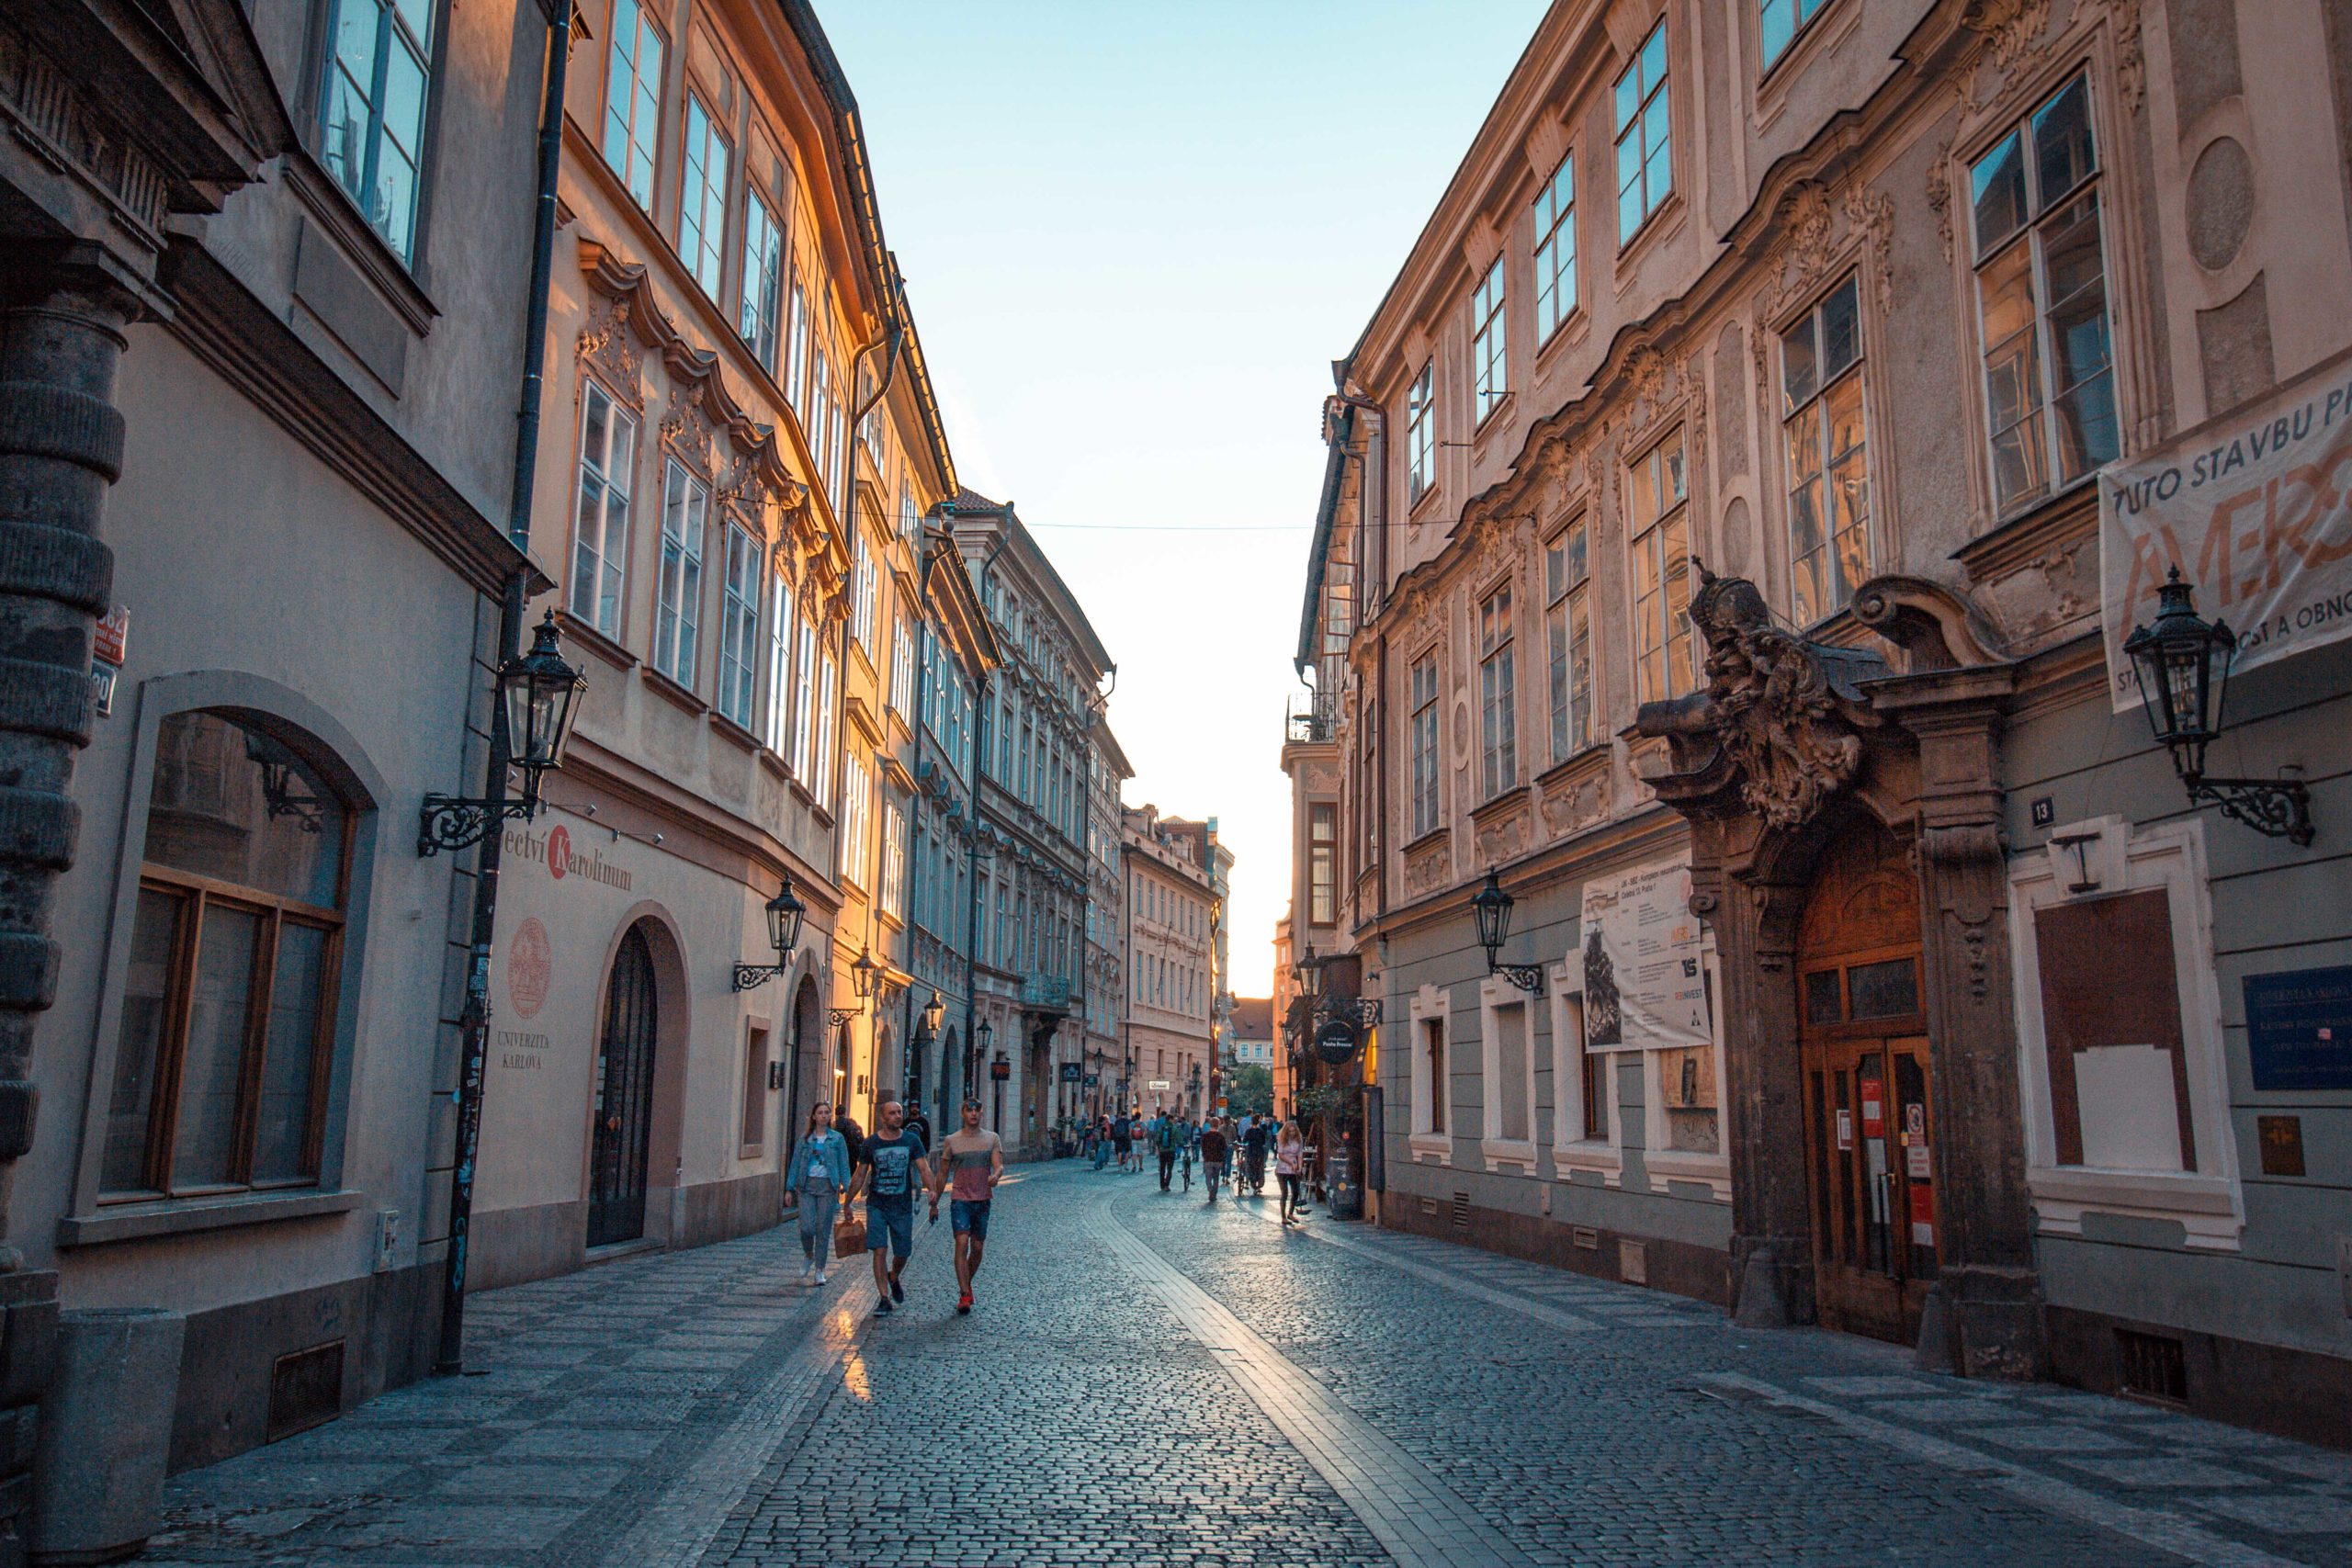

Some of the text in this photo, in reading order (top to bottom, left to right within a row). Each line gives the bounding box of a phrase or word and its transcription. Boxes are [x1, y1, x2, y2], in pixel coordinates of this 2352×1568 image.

[2113, 468, 2182, 518] TUTO
[2190, 402, 2313, 488] STAVBU
[2277, 615, 2290, 637] A
[2036, 803, 2048, 820] 13
[502, 829, 632, 891] ectví Karolinum
[497, 1031, 549, 1048] UNIVERZITA
[503, 1054, 541, 1069] KARLOVA
